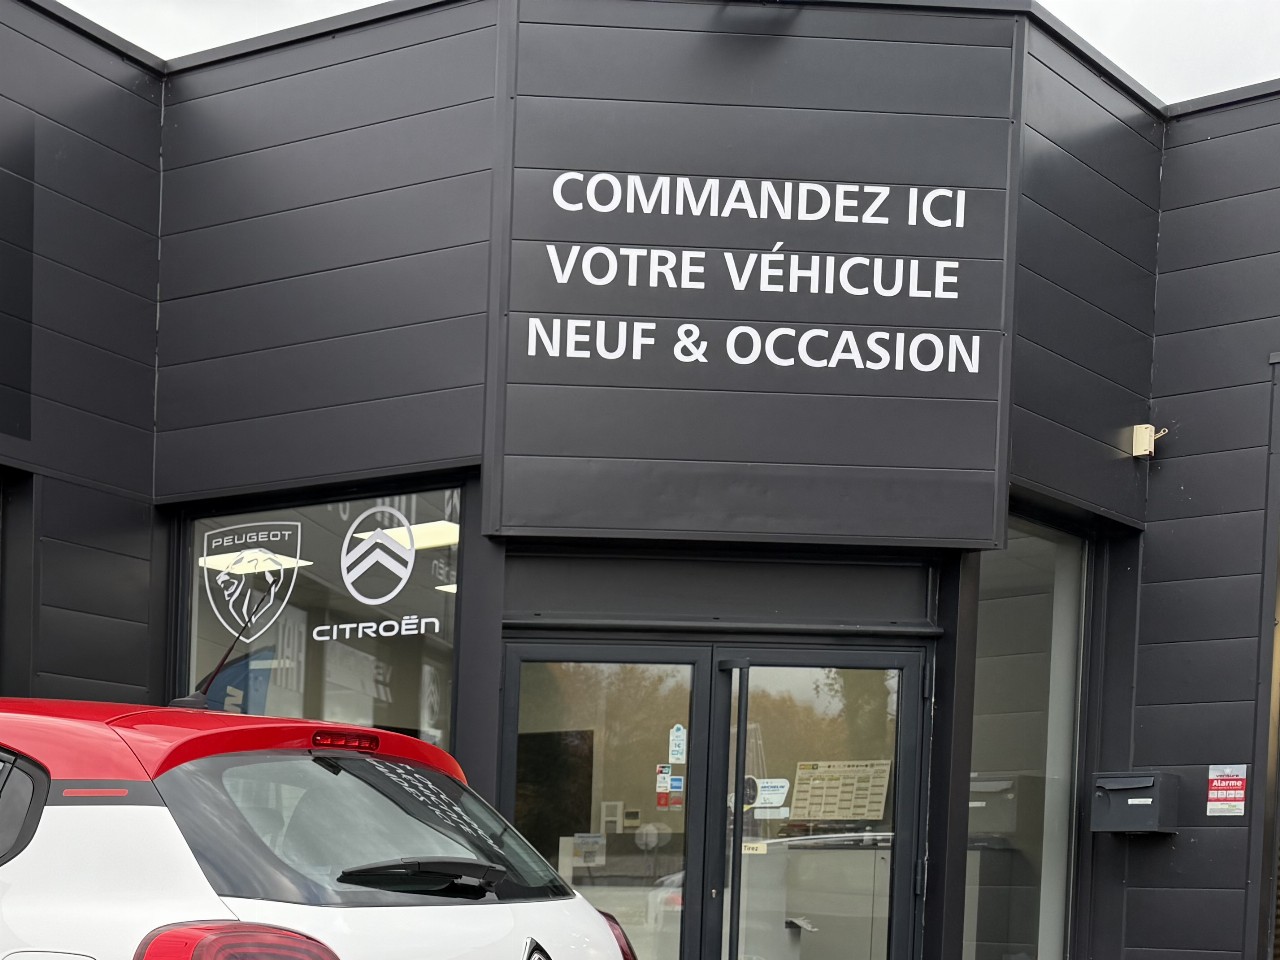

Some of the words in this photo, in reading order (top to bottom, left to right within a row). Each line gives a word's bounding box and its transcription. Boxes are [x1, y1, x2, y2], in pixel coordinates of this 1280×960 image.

[552, 171, 891, 226] COMMANDEZ
[907, 187, 966, 228] ICI
[545, 244, 706, 290] VOTRE
[723, 241, 959, 299] VÉHICULE
[527, 317, 656, 360] NEUF
[673, 322, 709, 363] &
[726, 325, 981, 374] OCCASION
[212, 531, 292, 549] PEUGEOT
[312, 615, 440, 641] CITROËN
[743, 844, 759, 852] Tirez
